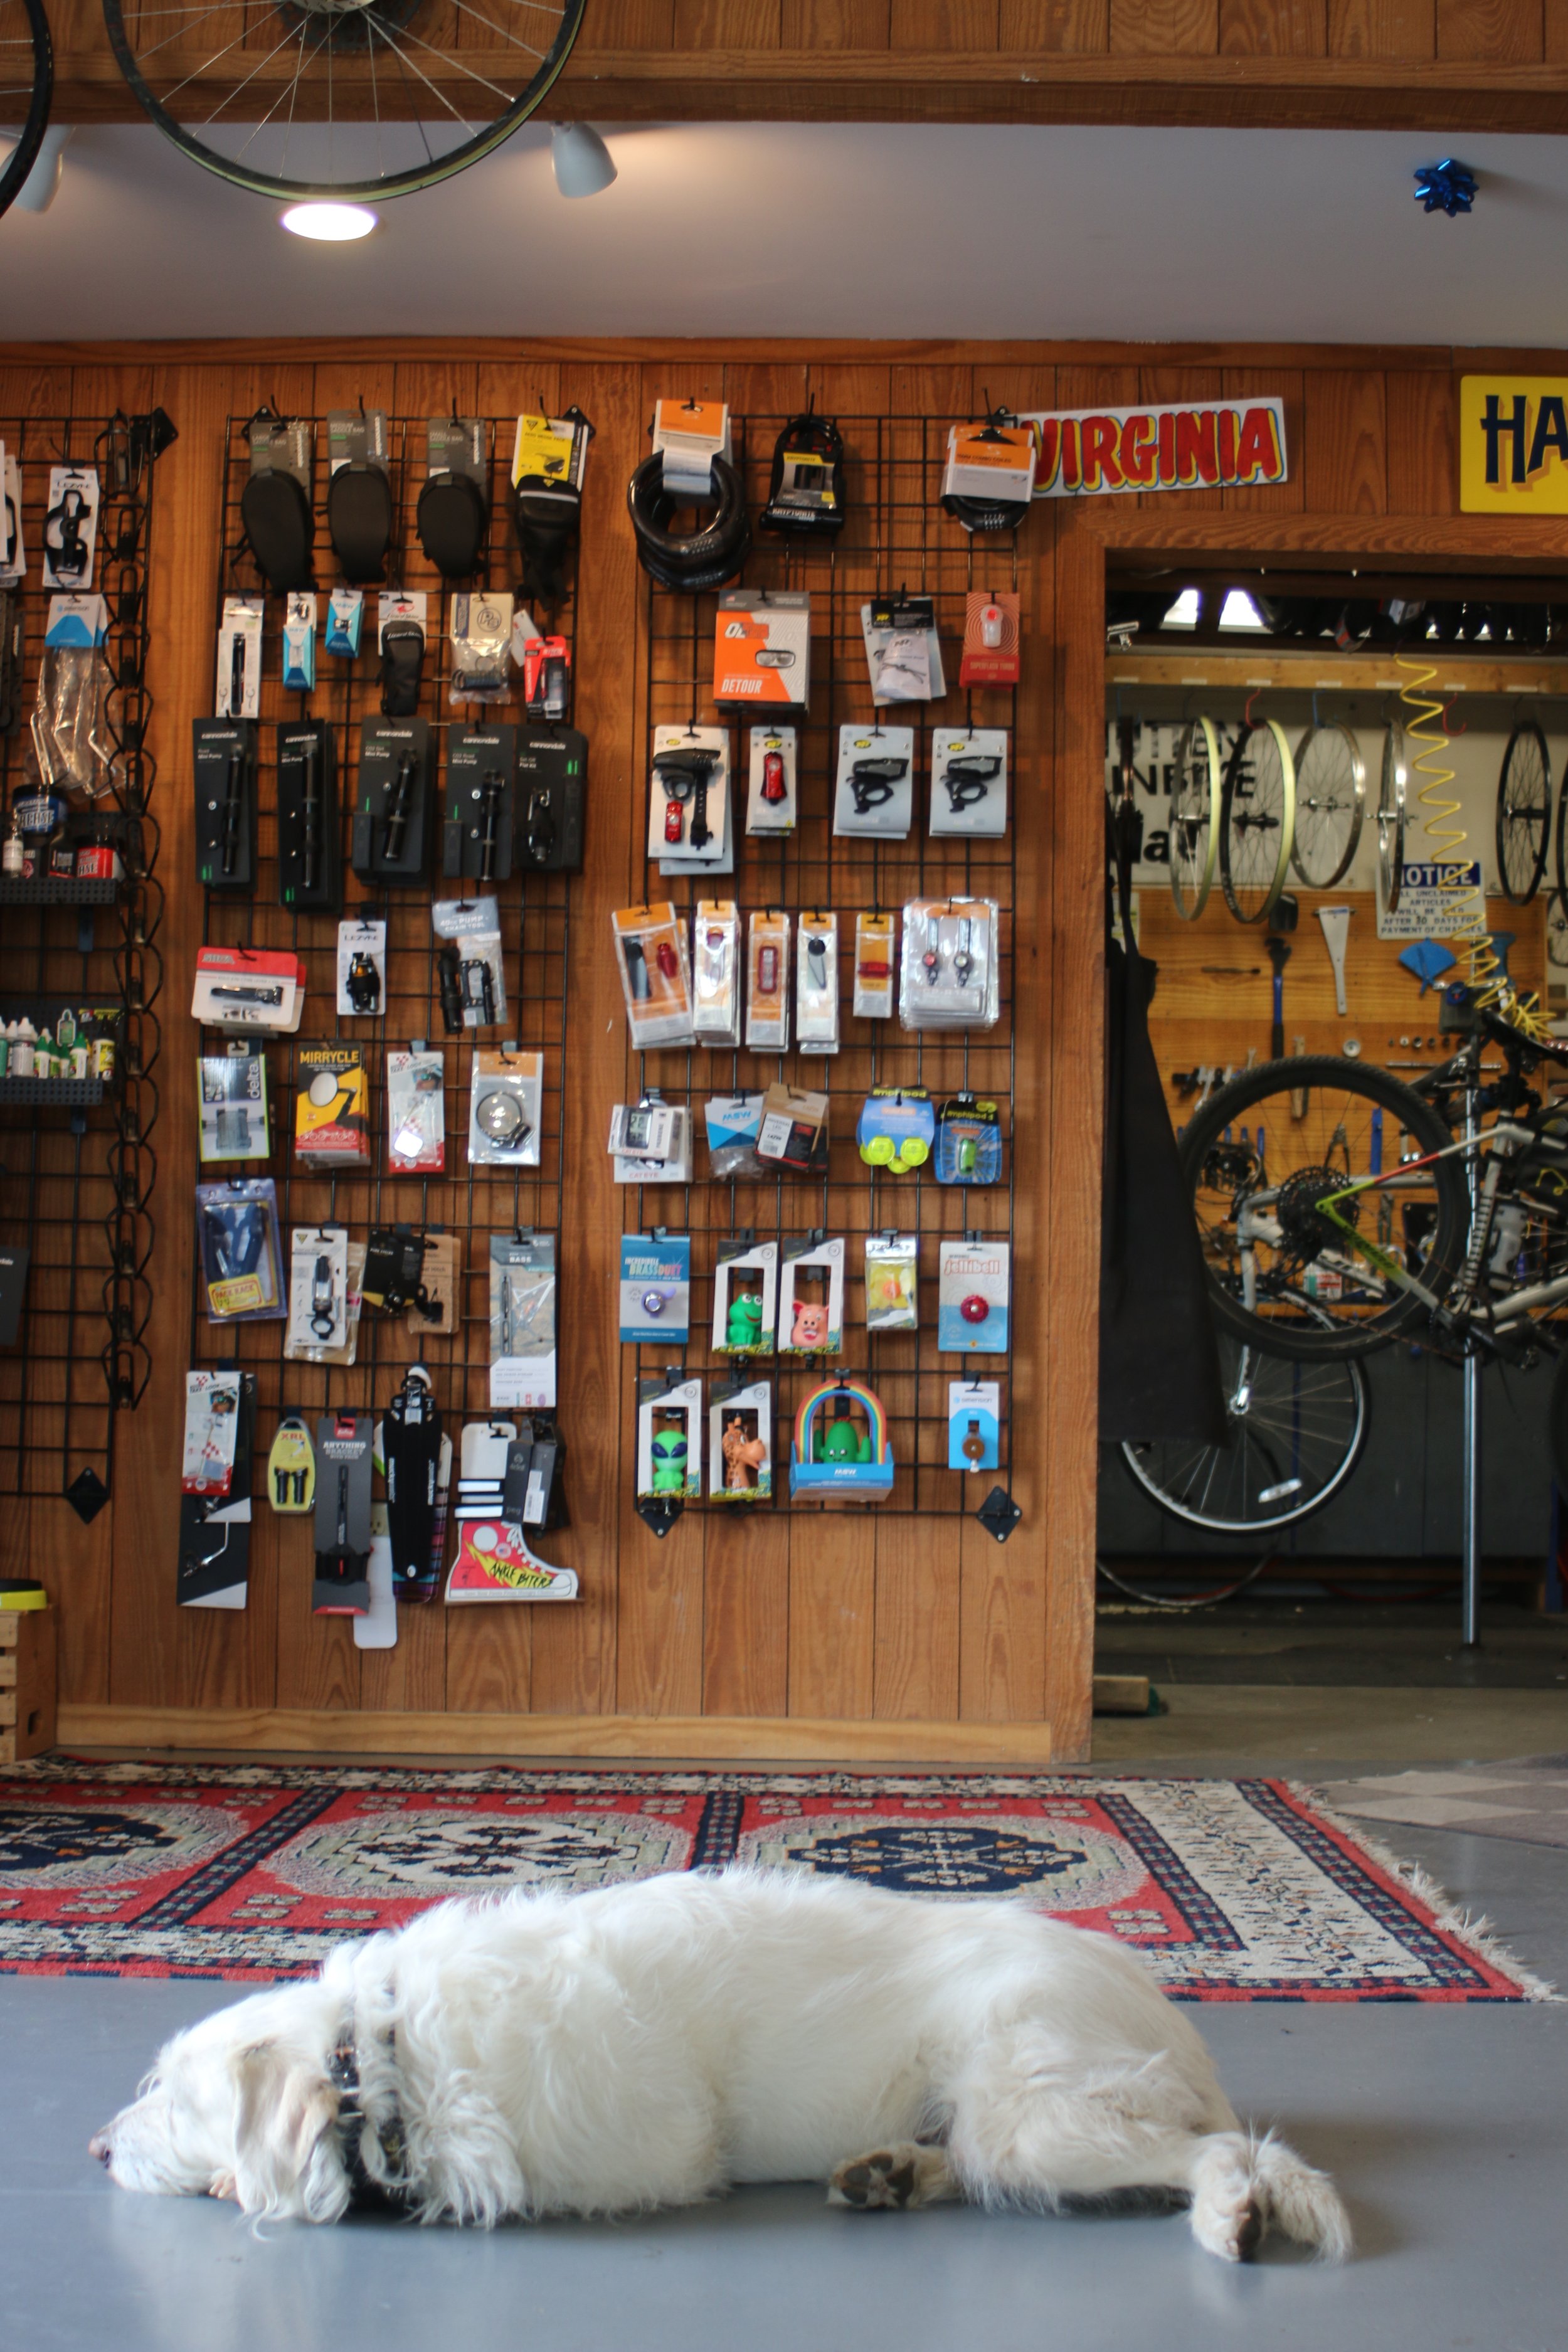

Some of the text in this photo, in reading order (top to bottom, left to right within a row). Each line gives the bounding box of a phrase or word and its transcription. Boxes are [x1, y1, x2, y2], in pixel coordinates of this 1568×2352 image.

[1020, 408, 1285, 491] VIRGINIA
[721, 678, 763, 694] DETOUR
[201, 731, 238, 739] cannondale
[285, 734, 317, 743] cannondale
[530, 741, 566, 750] cannondale
[1434, 916, 1458, 924] DAYS
[299, 1050, 359, 1065] MIRRYCLE
[246, 1061, 260, 1099] delta
[723, 1111, 751, 1121] MSW
[944, 1259, 1000, 1276] jellibell
[323, 1441, 366, 1449] ANYTHING
[490, 1562, 553, 1589] ANKLE BITERS
